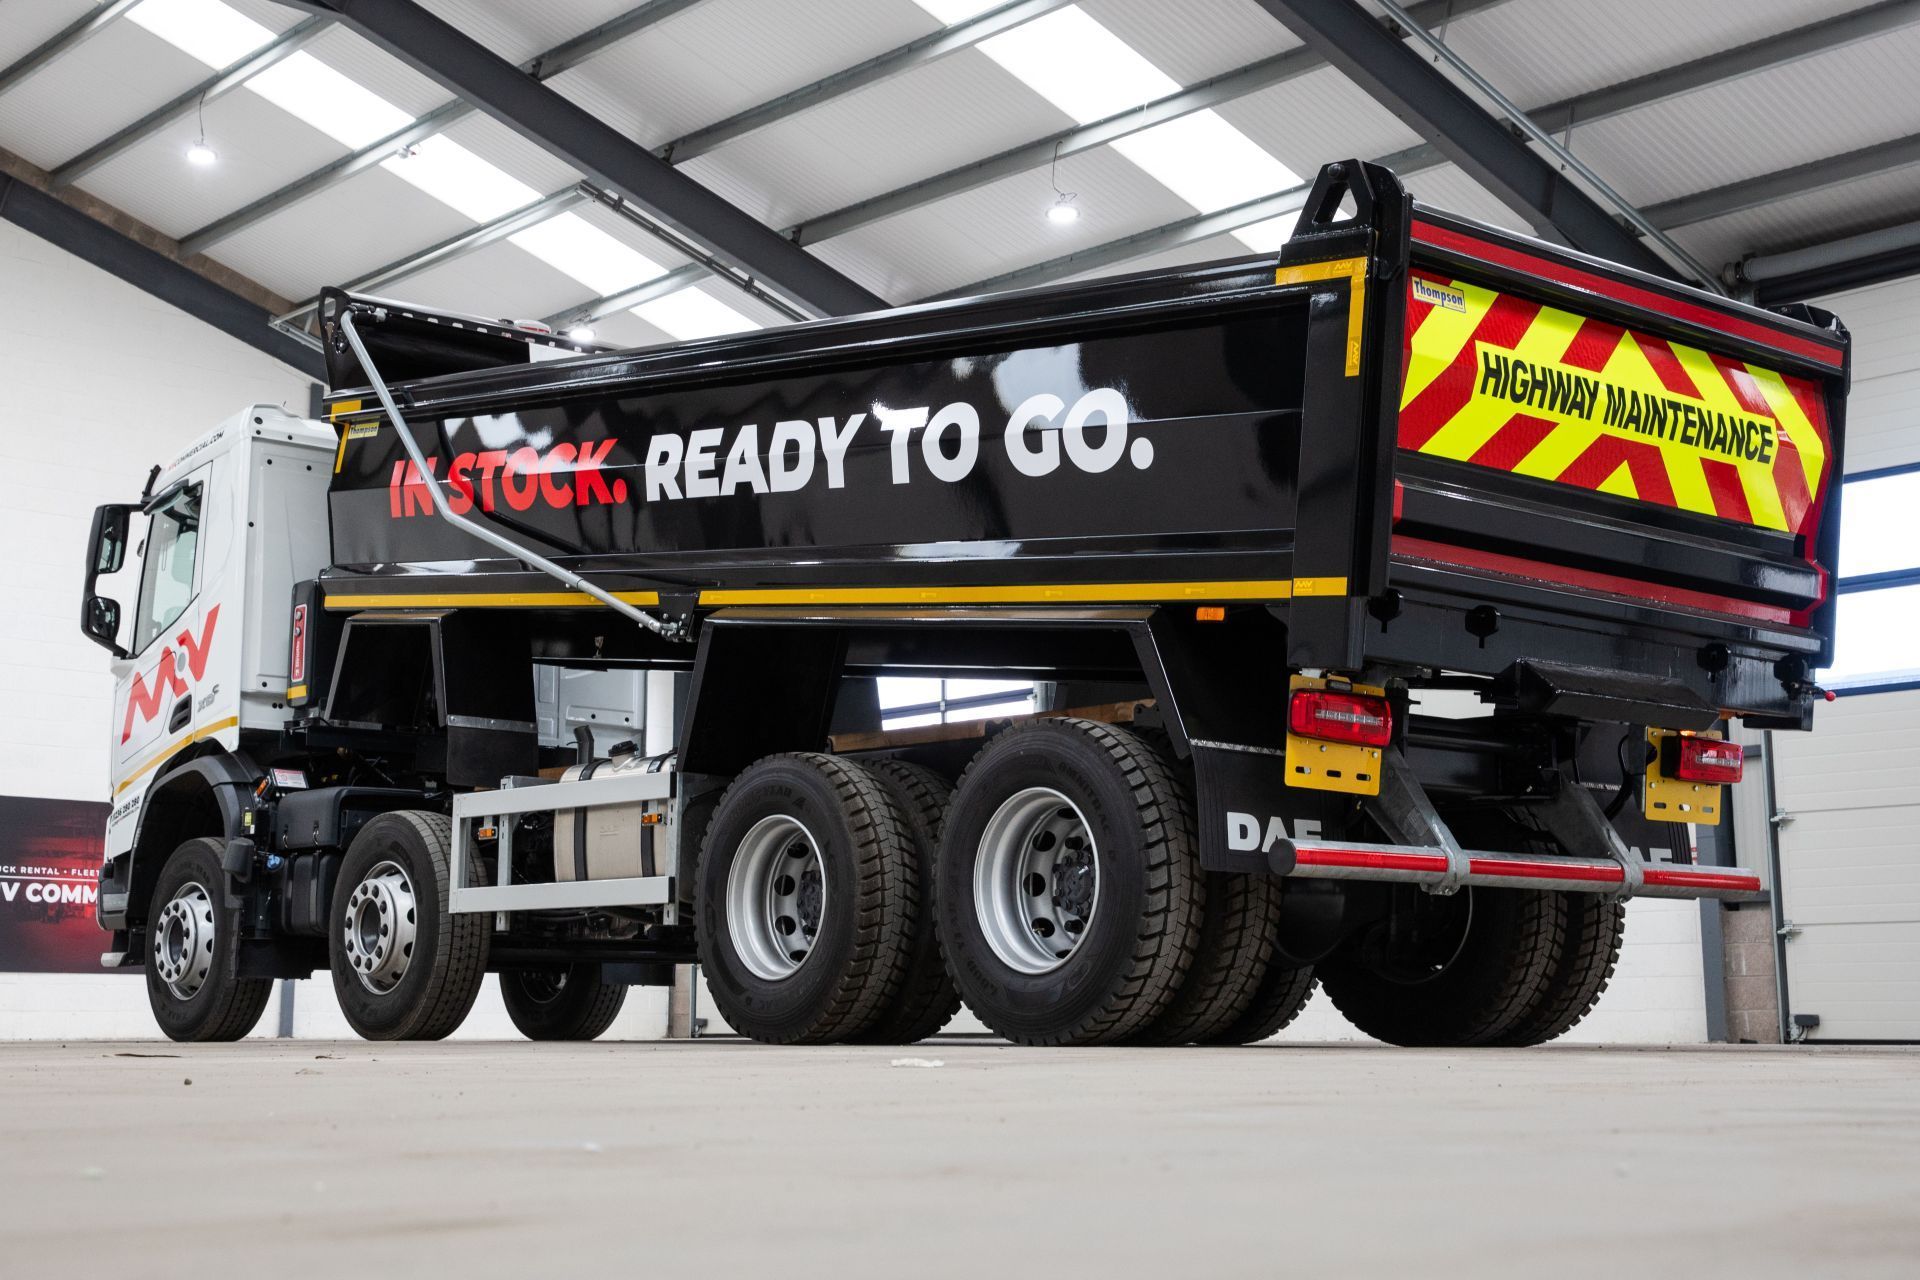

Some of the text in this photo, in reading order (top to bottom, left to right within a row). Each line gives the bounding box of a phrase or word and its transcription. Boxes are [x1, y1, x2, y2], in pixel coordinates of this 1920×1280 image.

[1413, 278, 1464, 307] Thompson
[1479, 351, 1774, 465] HIGHWAY MAINTENANCE
[389, 387, 1154, 519] IN STOCK. READY TO GO.
[0, 865, 16, 874] CK
[20, 866, 60, 875] RENTAL
